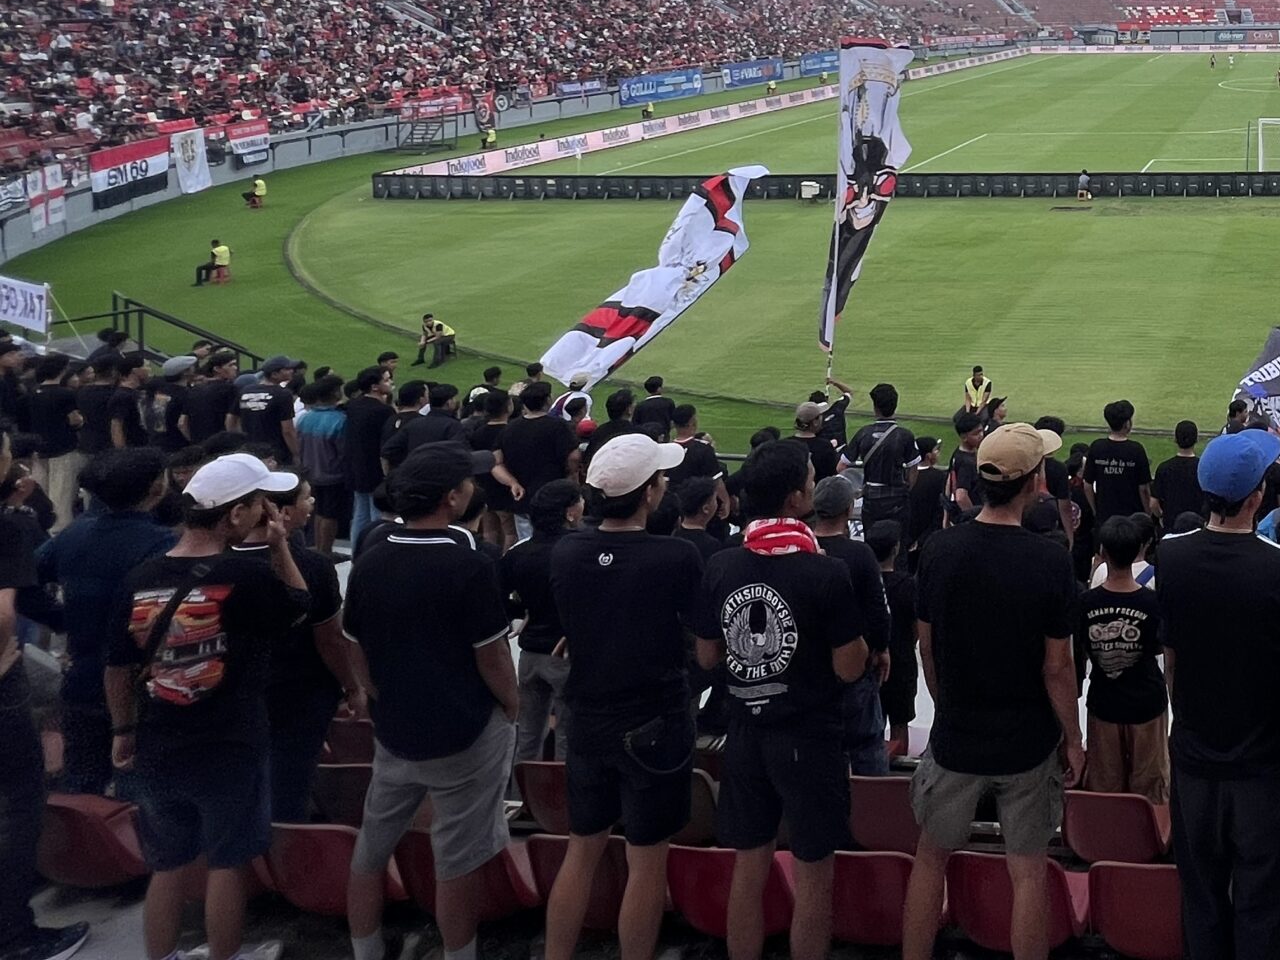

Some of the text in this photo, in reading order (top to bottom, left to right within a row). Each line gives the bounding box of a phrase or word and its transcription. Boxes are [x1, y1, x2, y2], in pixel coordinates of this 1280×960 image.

[505, 144, 540, 163] Indofood
[130, 159, 149, 180] 69
[447, 155, 487, 175] Indofood
[745, 663, 768, 679] THE
